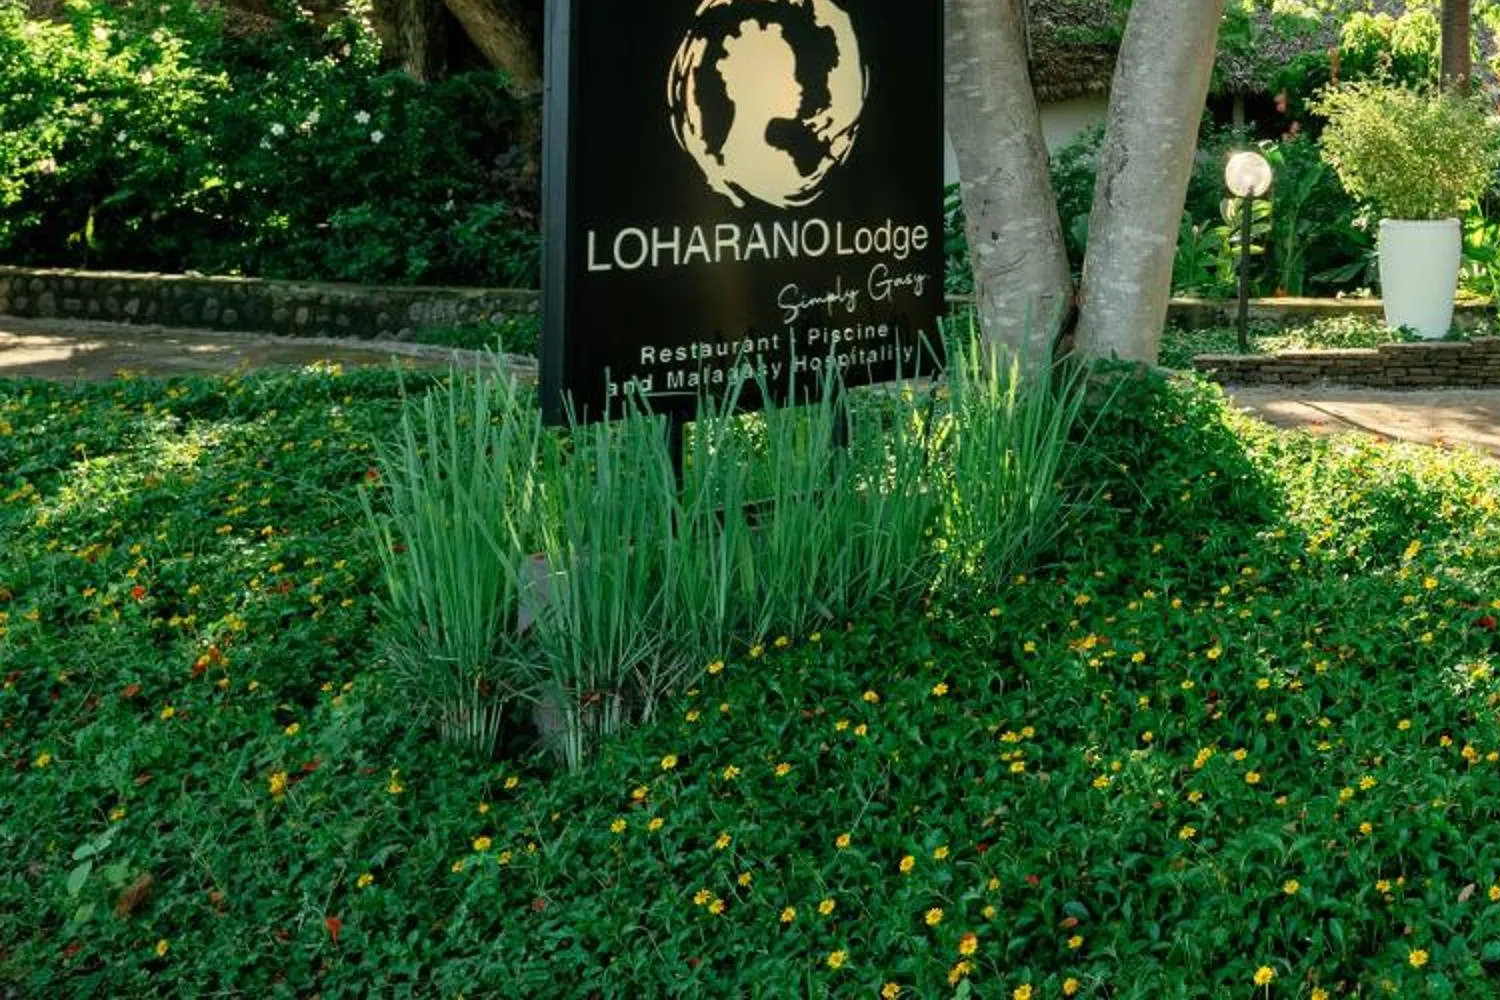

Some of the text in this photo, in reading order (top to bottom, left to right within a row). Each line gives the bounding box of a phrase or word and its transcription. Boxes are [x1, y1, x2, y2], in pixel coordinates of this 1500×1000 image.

[587, 218, 929, 271] LOHARANO Lodge
[777, 275, 860, 325] Simply
[640, 323, 889, 365] Restaurant Piscine
[607, 373, 653, 397] and
